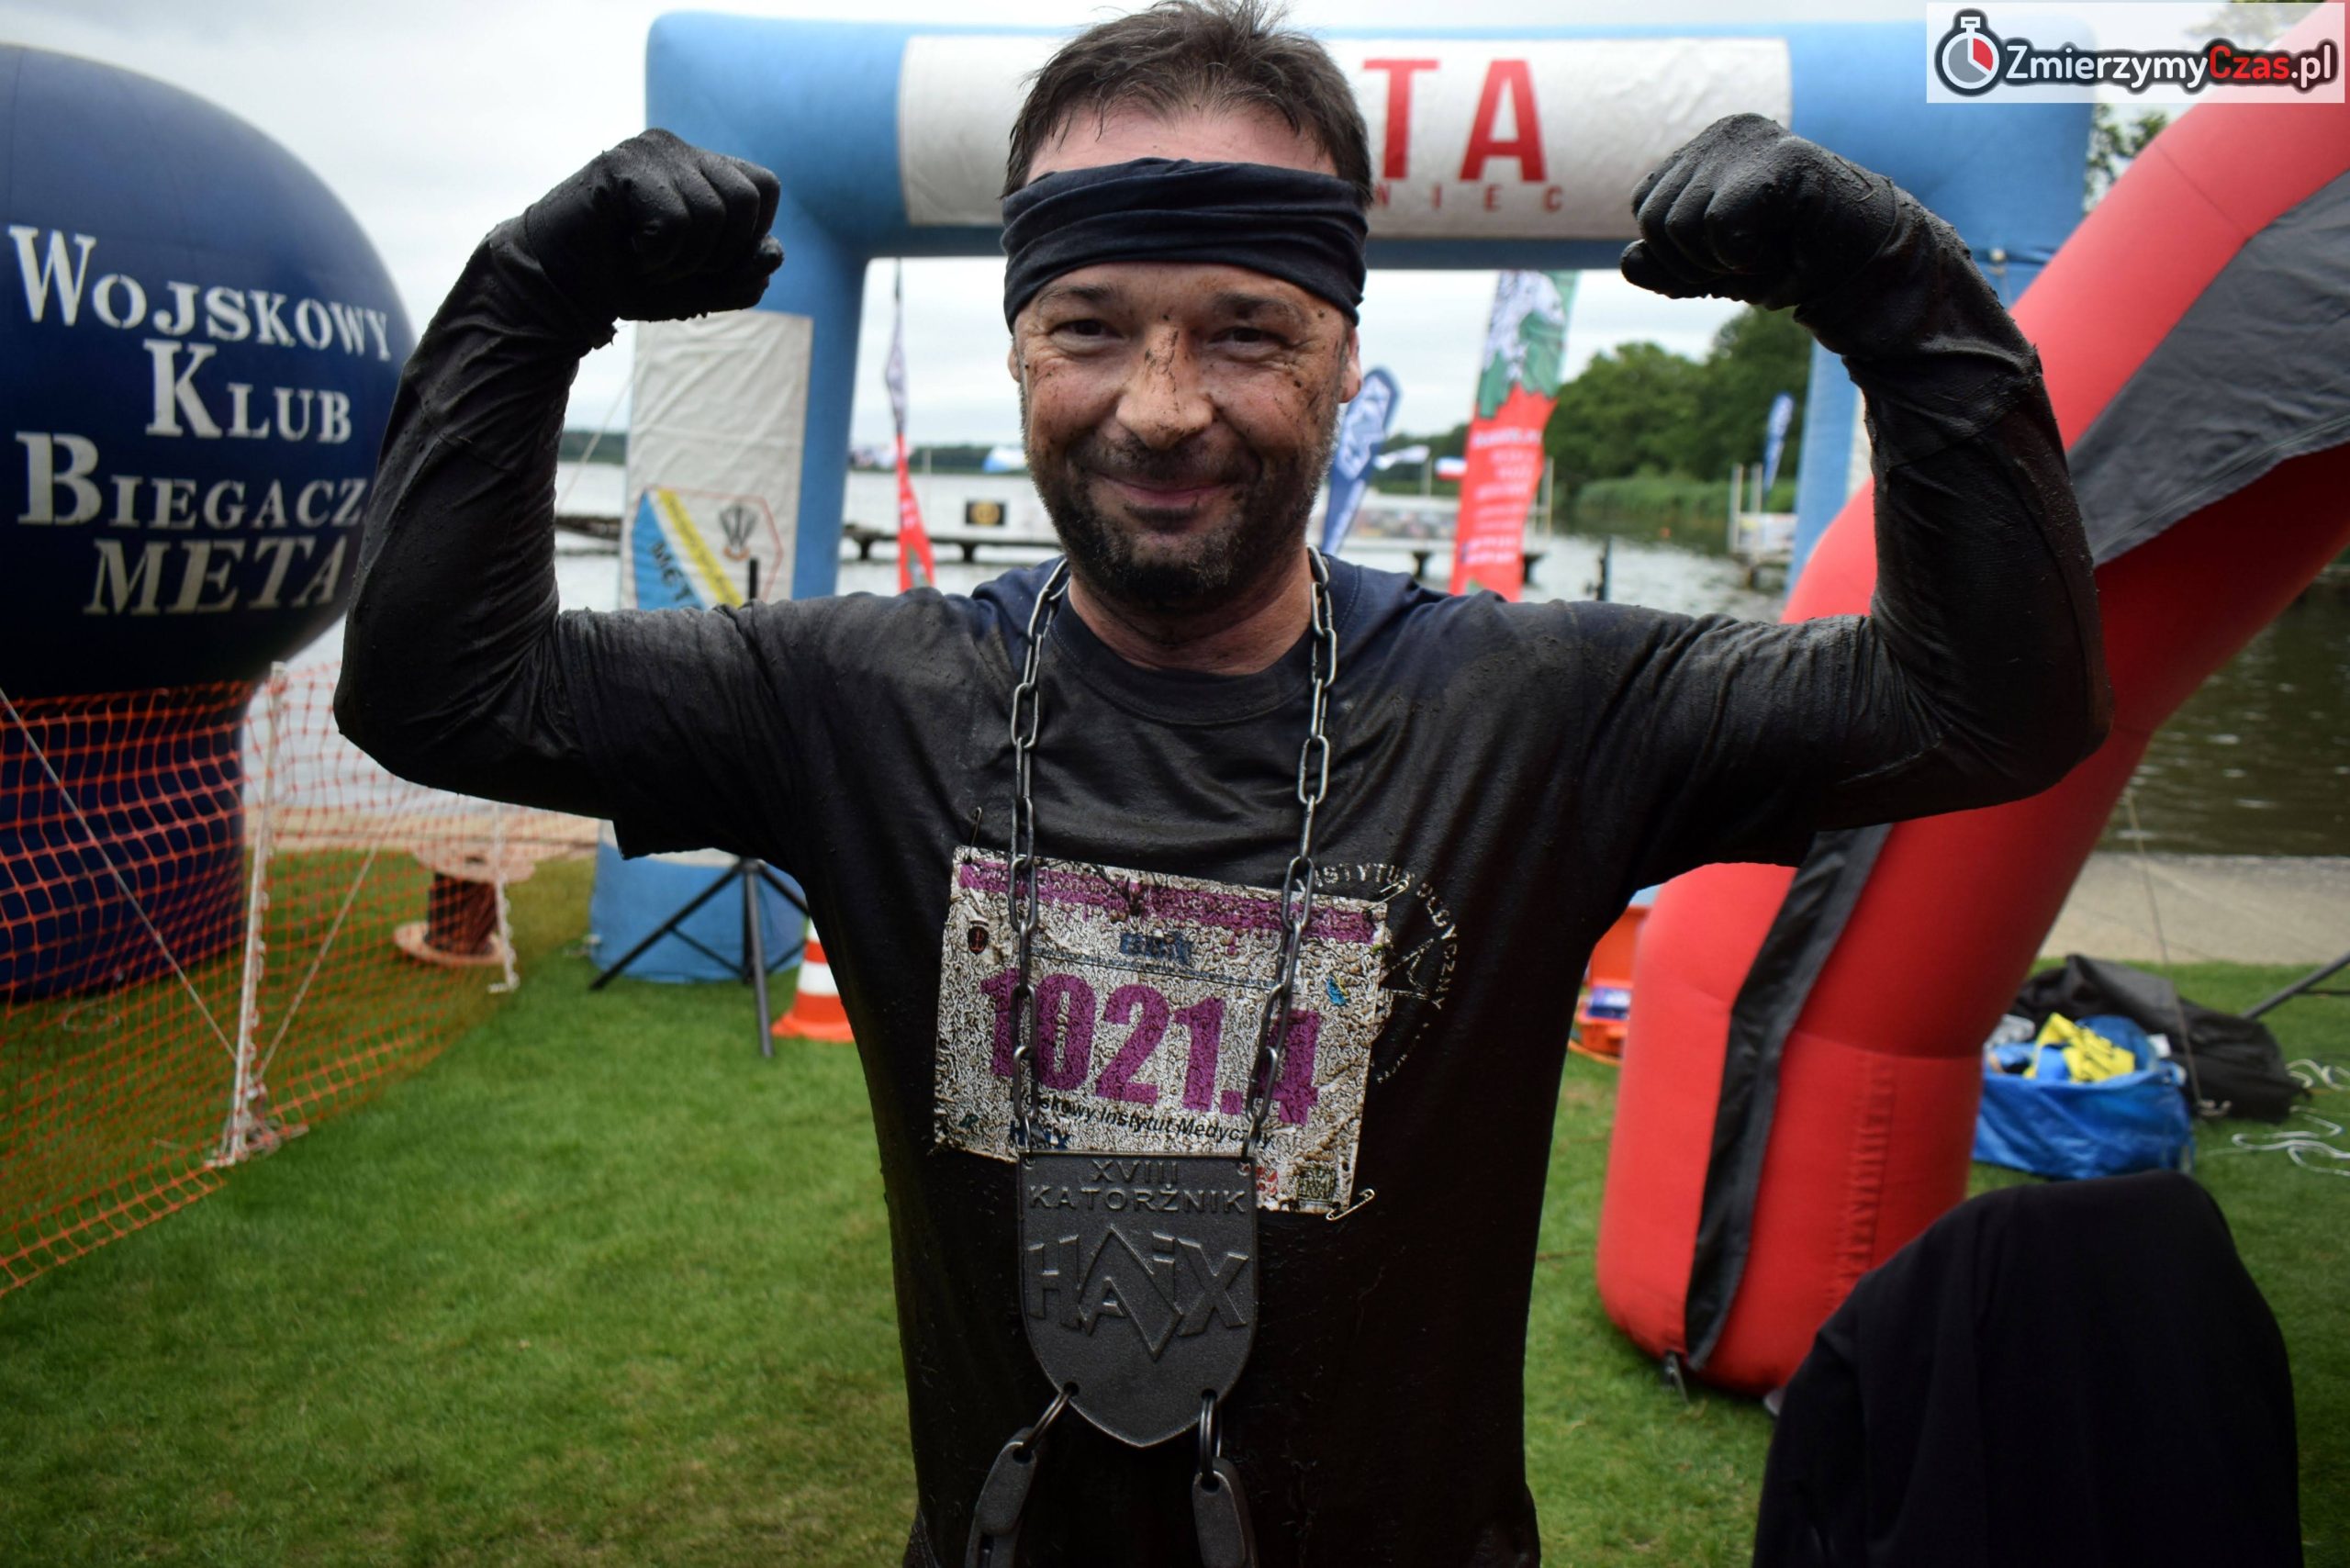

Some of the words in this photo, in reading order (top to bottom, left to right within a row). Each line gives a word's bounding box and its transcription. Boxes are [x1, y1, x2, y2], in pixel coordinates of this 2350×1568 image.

[1362, 58, 1549, 182] TA
[8, 224, 392, 361] WOJSKOWY
[143, 338, 352, 443] KLUB
[15, 431, 367, 531] BIEGACZ
[82, 535, 349, 616] META
[979, 967, 1320, 1126] 1021.4
[1027, 1183, 1248, 1215] KATORŻNIK
[1091, 1158, 1180, 1185] XVIII
